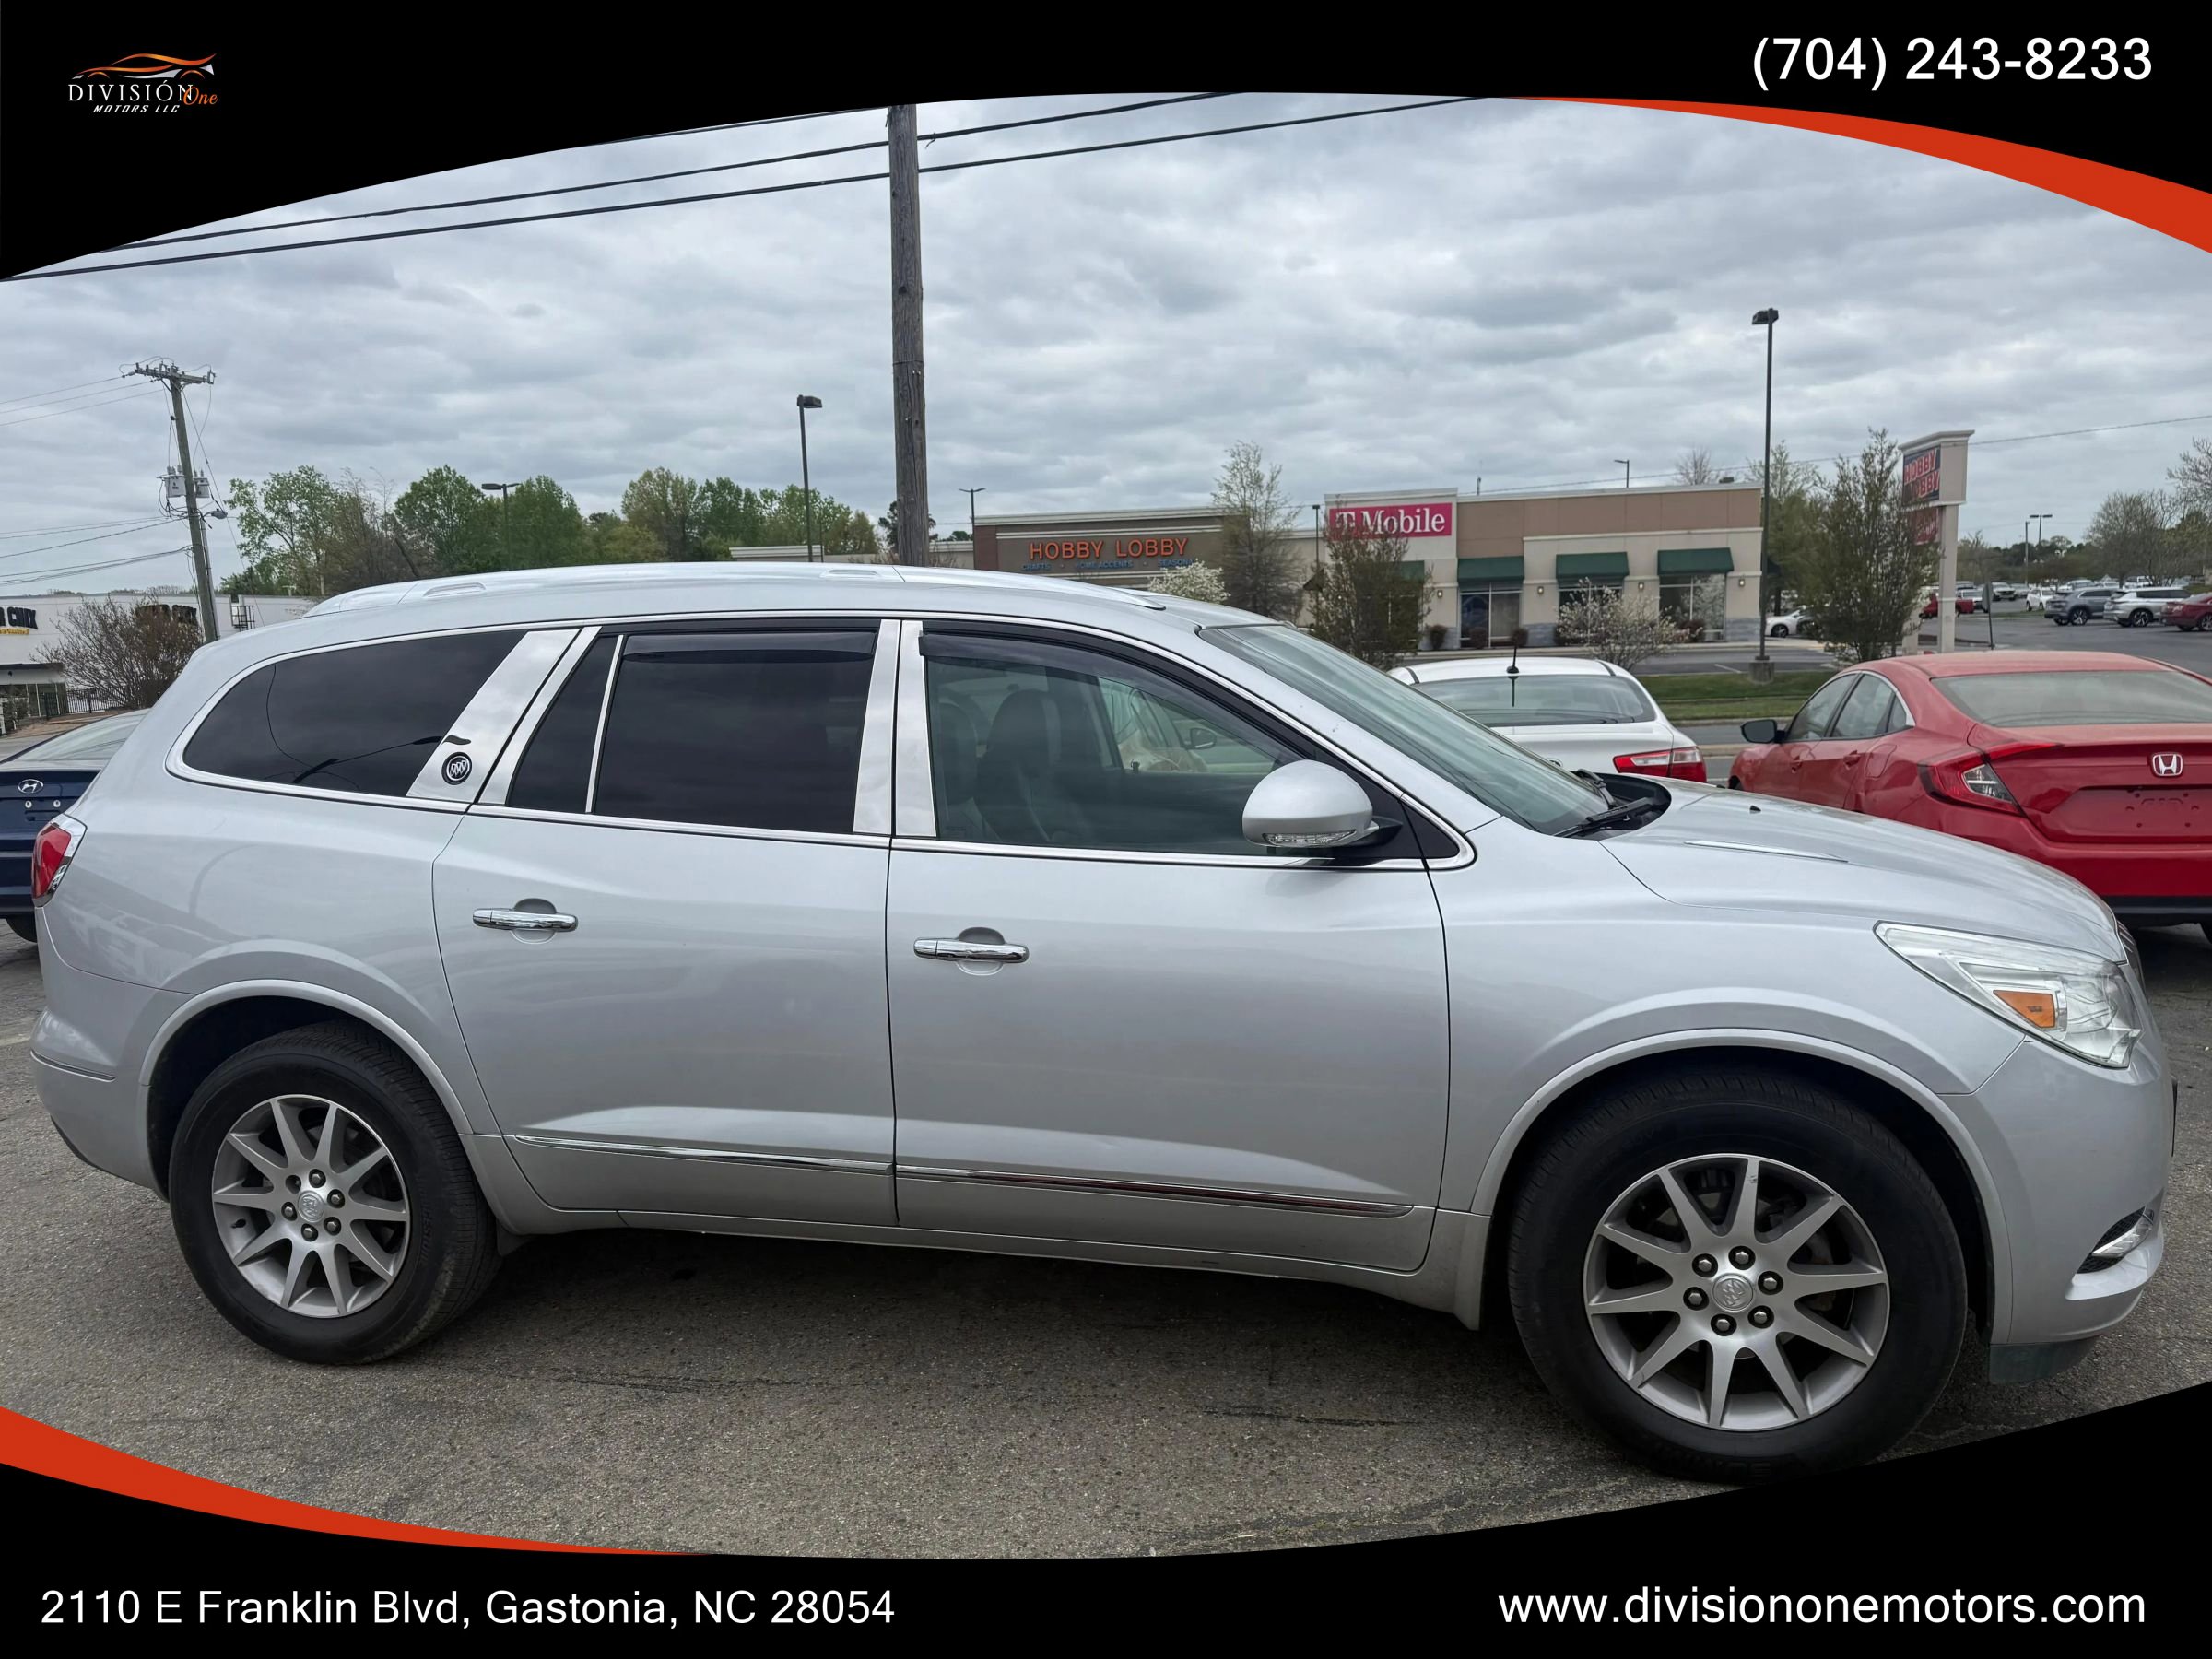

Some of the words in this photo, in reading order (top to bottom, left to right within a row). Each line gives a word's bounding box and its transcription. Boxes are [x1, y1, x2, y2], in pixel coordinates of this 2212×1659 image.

[1904, 448, 1936, 486] HOBBY
[1904, 471, 1939, 504] BBY
[1360, 507, 1445, 535] Mobile
[1029, 540, 1104, 561] HOBBY
[1115, 537, 1189, 559] LOBBY
